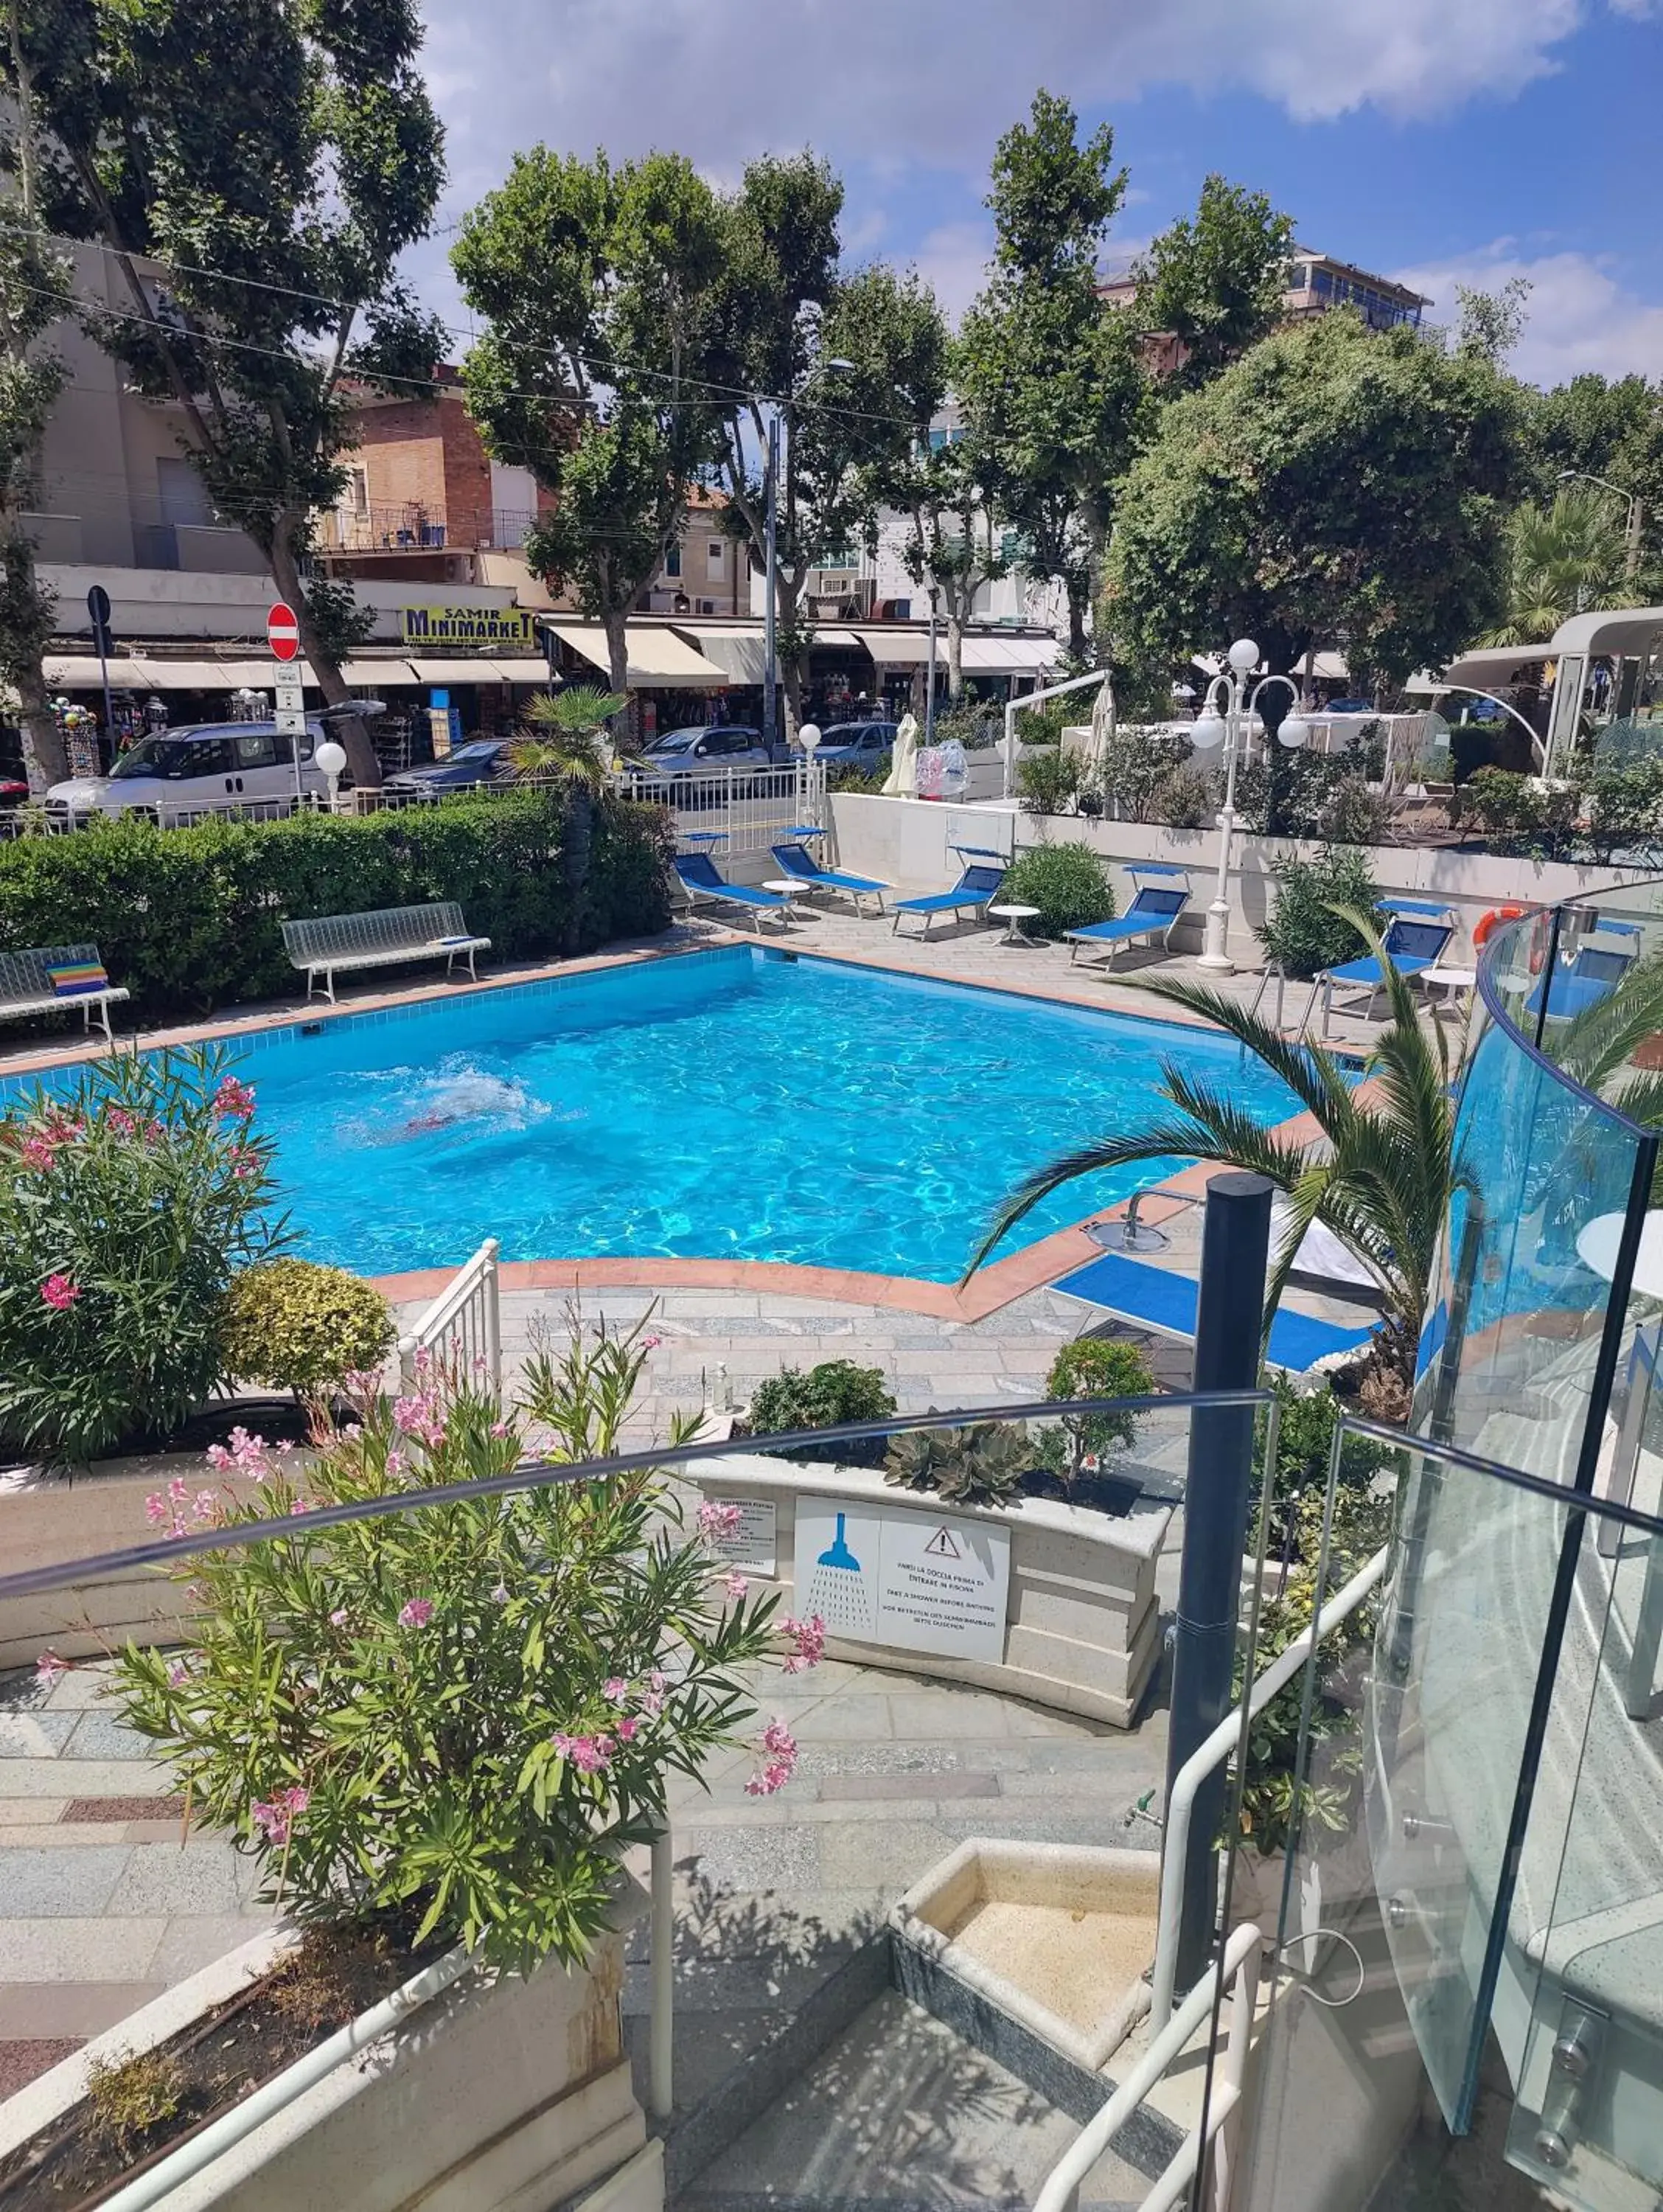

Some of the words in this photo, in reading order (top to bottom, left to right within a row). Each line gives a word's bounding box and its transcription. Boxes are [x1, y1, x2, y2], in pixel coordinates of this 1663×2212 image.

[444, 608, 501, 620] SAMIR
[406, 608, 531, 638] MINIMARKET
[909, 1573, 938, 1587] ENTRARE
